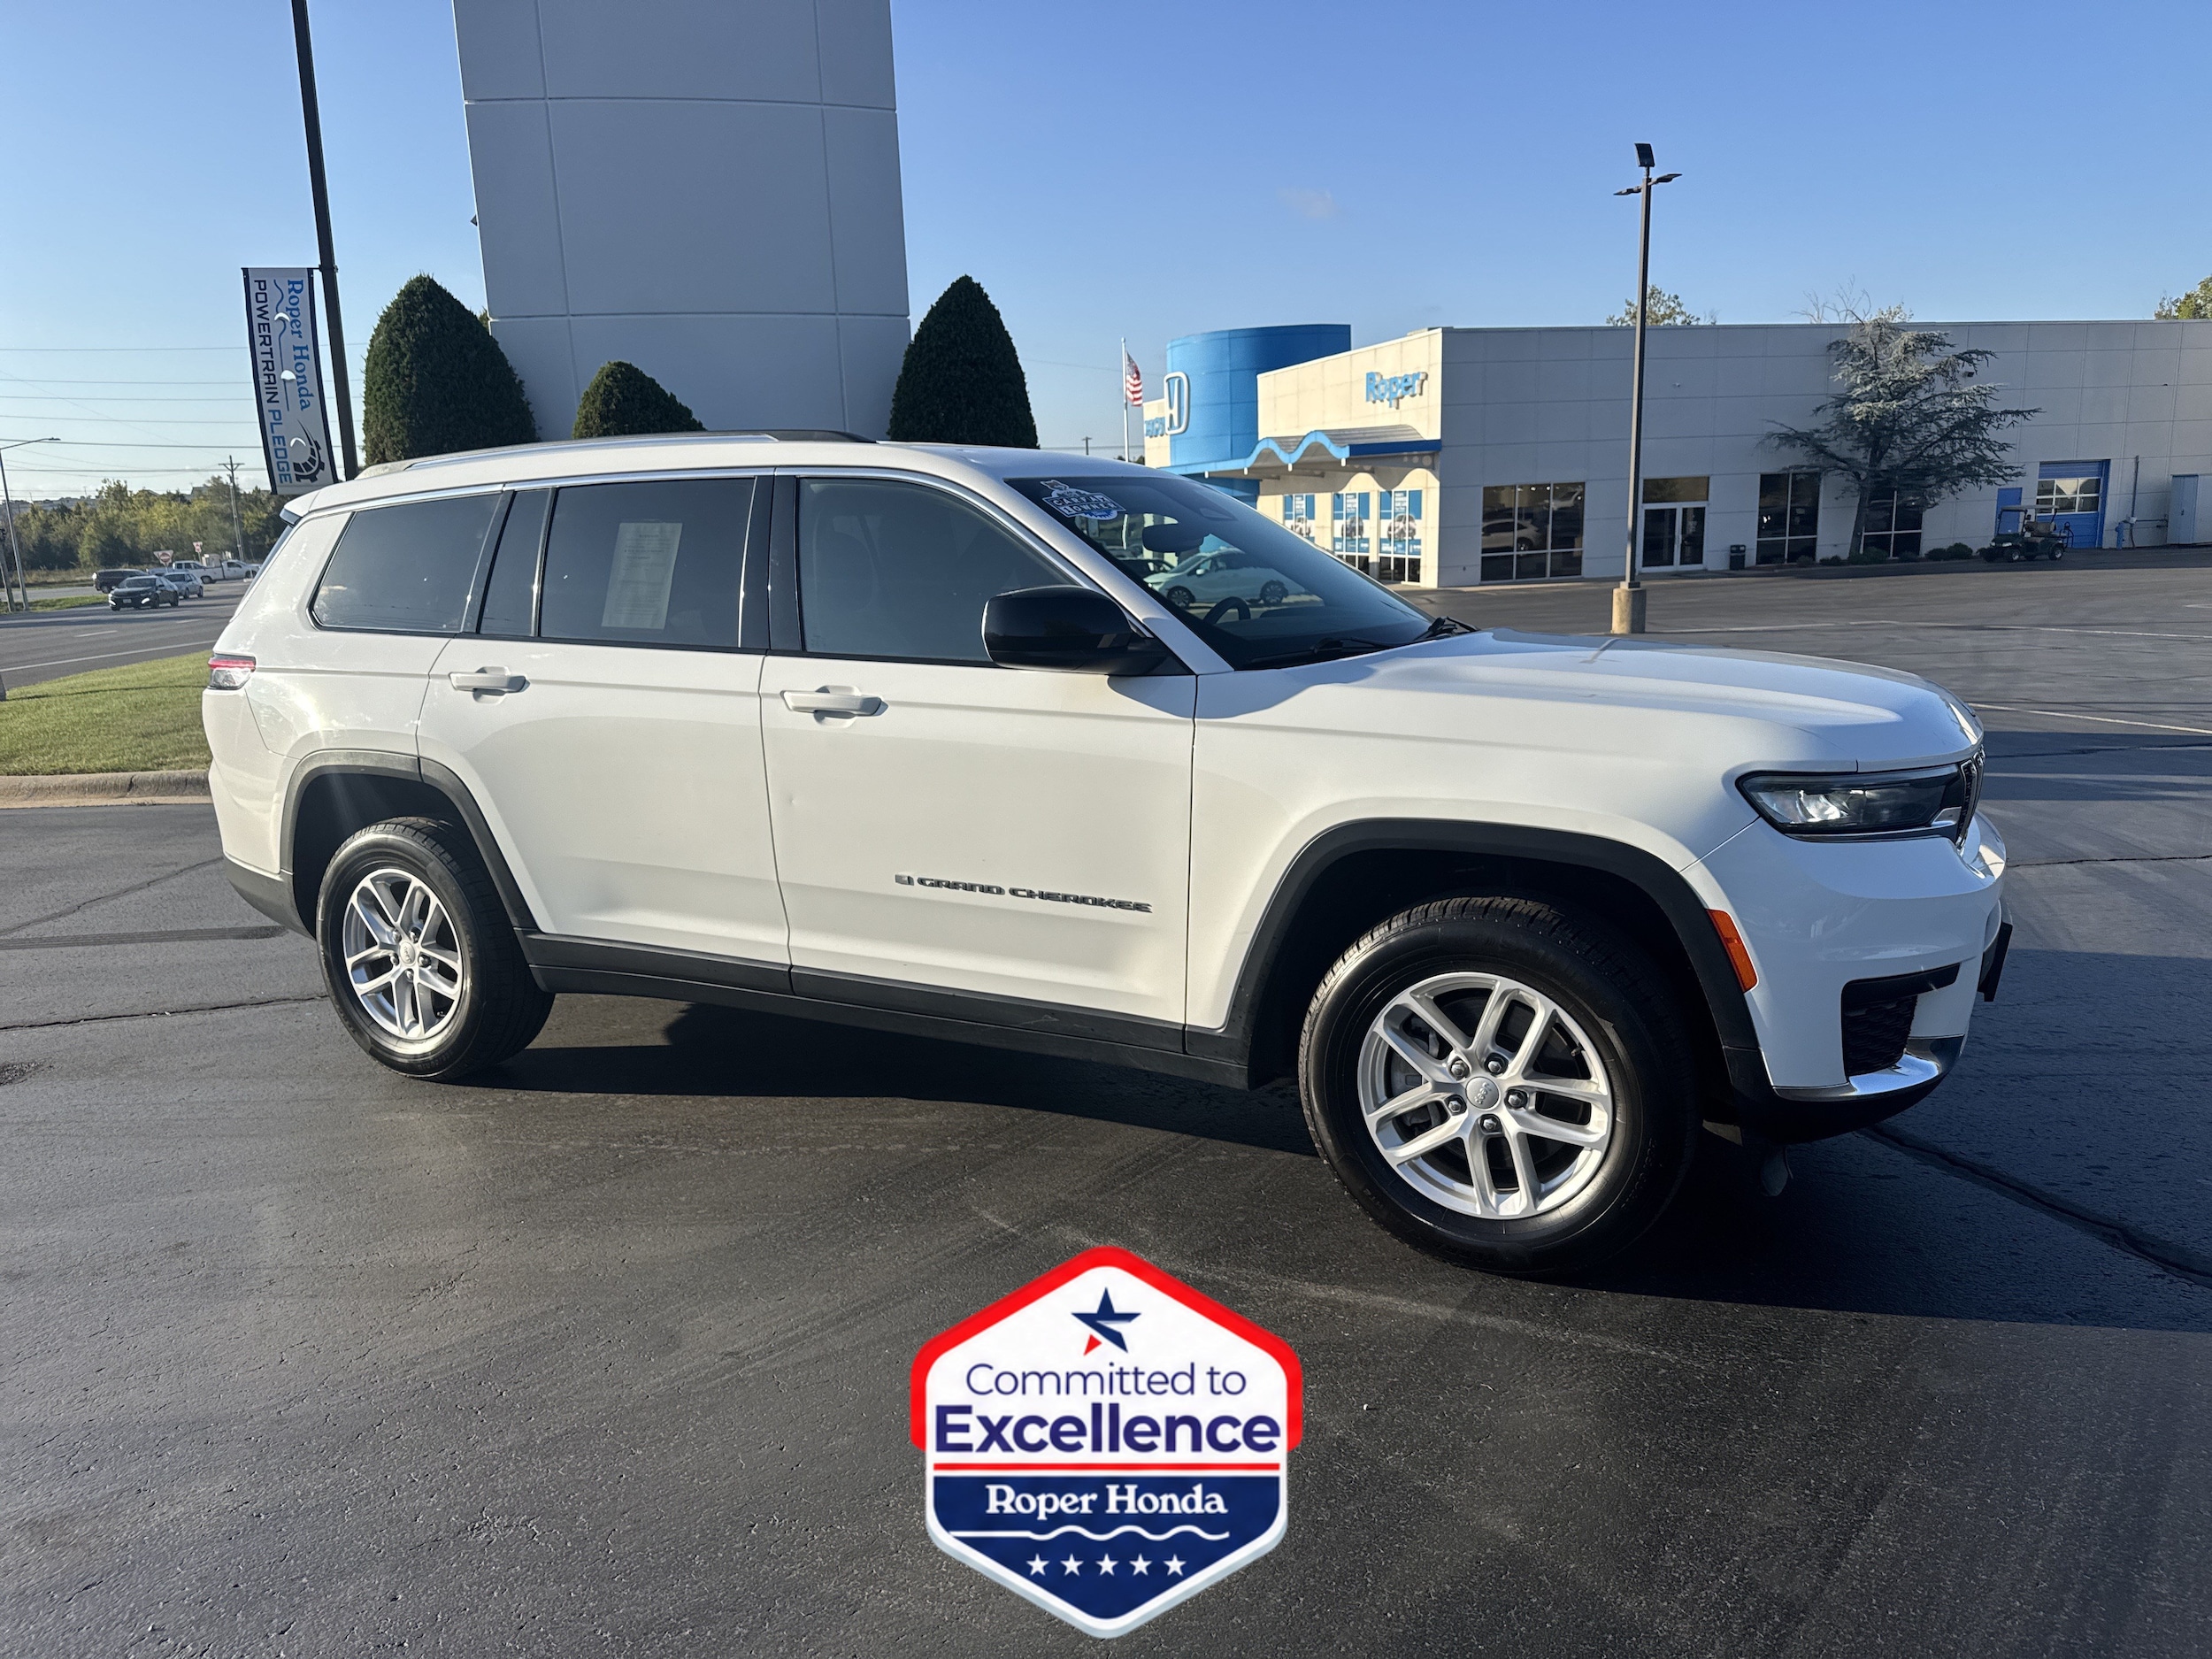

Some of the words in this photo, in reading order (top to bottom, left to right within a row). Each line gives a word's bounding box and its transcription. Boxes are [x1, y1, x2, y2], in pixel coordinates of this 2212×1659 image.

[286, 279, 304, 339] Roper
[253, 279, 280, 403] POWERTRAIN
[268, 409, 293, 484] PLEDGE
[292, 343, 314, 411] Honda
[1366, 371, 1426, 409] Roper
[1073, 503, 1117, 512] OWNER
[917, 877, 1006, 895] GRAND
[1009, 887, 1153, 914] CHEROKEE
